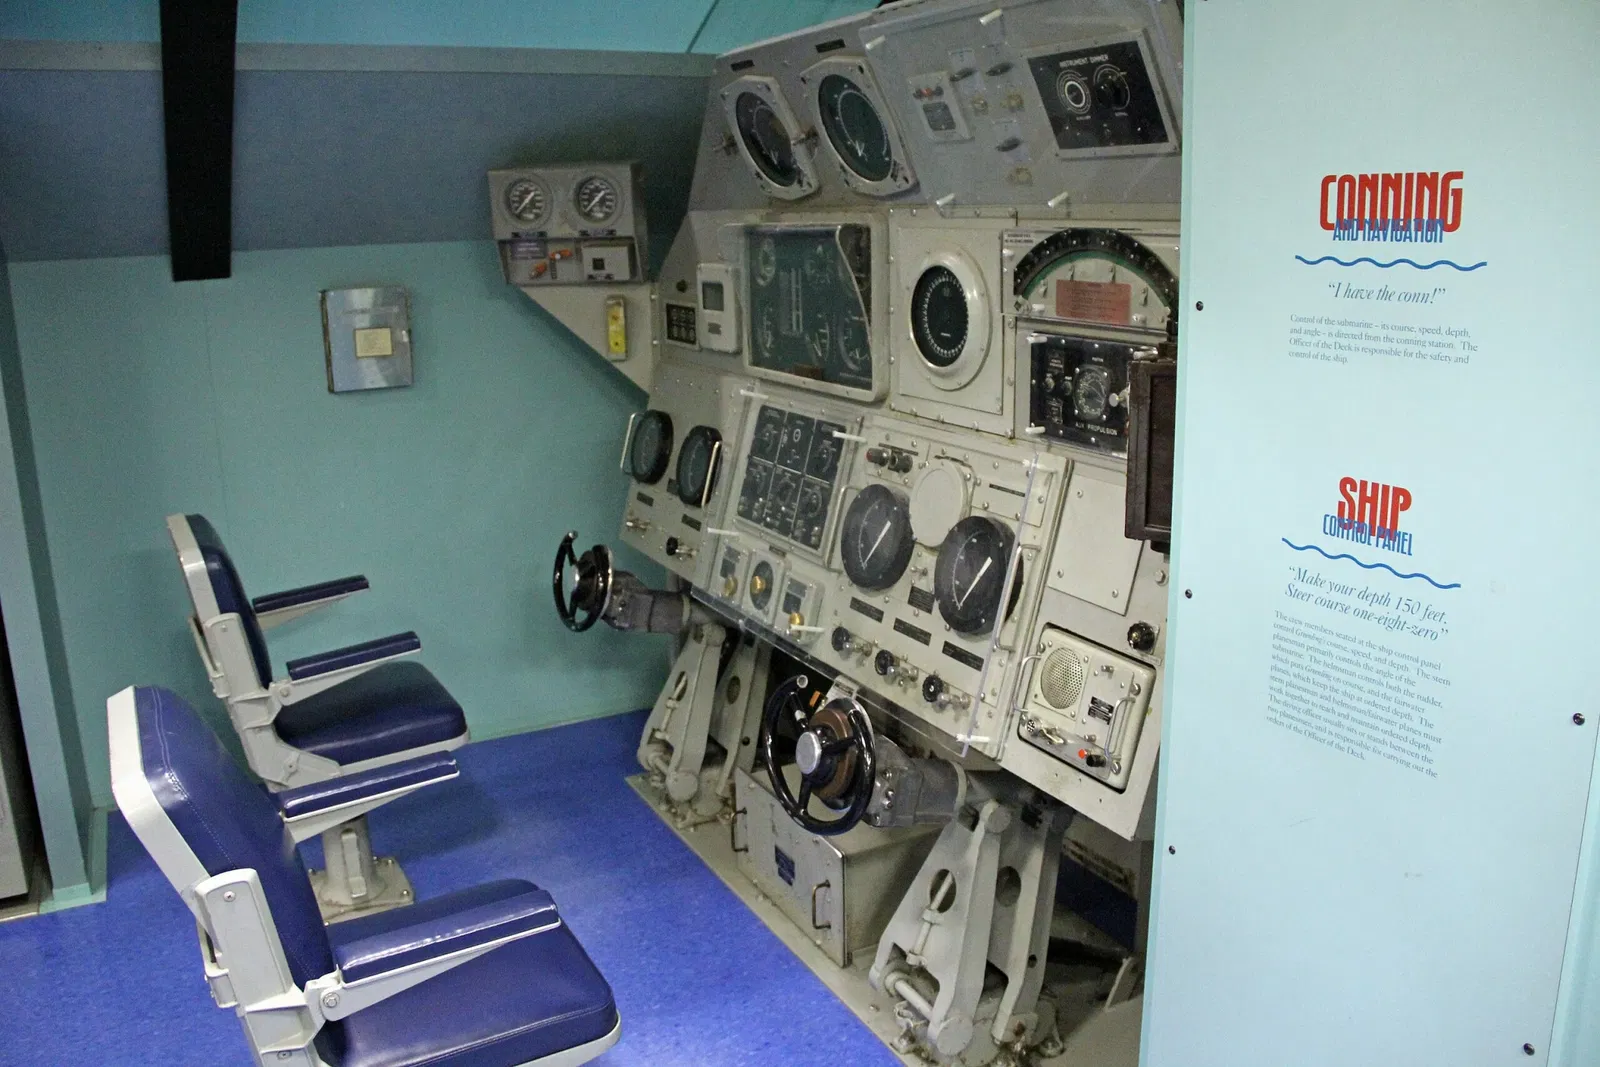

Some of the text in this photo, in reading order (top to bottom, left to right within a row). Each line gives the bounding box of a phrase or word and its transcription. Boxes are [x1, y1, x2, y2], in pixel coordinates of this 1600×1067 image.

[1059, 58, 1088, 67] INSTRUMENT
[1320, 171, 1464, 232] CONNING
[1333, 219, 1443, 243] AND NAVIGATION
[1291, 314, 1315, 323] Control
[1324, 317, 1336, 325] the
[1337, 319, 1373, 328] submarine
[1344, 284, 1374, 300] have
[1377, 285, 1395, 302] the
[1398, 287, 1446, 304] conn!”
[1290, 337, 1312, 347] Officer
[1322, 341, 1332, 349] the
[1334, 342, 1352, 351] Deck
[1362, 347, 1401, 356] responsible
[1404, 349, 1413, 358] for
[1416, 351, 1427, 359] the
[1430, 353, 1451, 364] safety
[1304, 328, 1321, 338] angle
[1335, 330, 1363, 340] directed
[1365, 333, 1381, 342] from
[1397, 339, 1426, 348] conning
[1461, 342, 1478, 351] The
[1321, 352, 1331, 361] the
[1333, 354, 1348, 364] ship.
[1088, 424, 1118, 435] PROPULSION
[1323, 514, 1413, 556] CONTROL PANEL
[1338, 476, 1412, 542] SHIP
[1286, 583, 1448, 641] Steer course one-eight-zero”
[1289, 567, 1447, 625] “Make your depth 150 feet.
[1273, 623, 1294, 634] control
[1375, 656, 1386, 665] and
[1415, 667, 1430, 680] The
[1432, 675, 1450, 687] stern
[1273, 632, 1416, 687] planesman primarily controls the angle of the
[1275, 610, 1287, 620] The
[1289, 617, 1302, 625] crew
[1305, 622, 1334, 636] members
[1336, 632, 1356, 643] seated
[1366, 640, 1376, 650] the
[1379, 644, 1393, 658] ship
[1394, 651, 1419, 664] control
[1421, 660, 1441, 671] panel
[1271, 664, 1291, 678] planes,
[1293, 672, 1311, 684] which
[1313, 677, 1328, 692] keep
[1330, 684, 1339, 694] the
[1342, 689, 1355, 702] ship
[1364, 698, 1390, 713] ordered
[1419, 716, 1434, 729] The
[1272, 644, 1442, 709] submarine. The helmsman controls both the rudder,
[1272, 653, 1290, 665] which
[1291, 661, 1303, 670] puts
[1367, 688, 1380, 698] and
[1382, 692, 1392, 702] the
[1394, 695, 1425, 714] fairwater
[1266, 715, 1366, 761] orders of the Officer of the Deck.
[1268, 693, 1281, 705] The
[1283, 698, 1301, 715] diving
[1302, 707, 1322, 721] officer
[1324, 717, 1344, 732] usually
[1347, 725, 1357, 735] sits
[1367, 734, 1388, 747] stands
[1390, 740, 1419, 759] between
[1422, 754, 1433, 765] the
[1270, 675, 1284, 685] stern
[1286, 679, 1318, 697] planesman
[1320, 693, 1331, 702] and
[1400, 722, 1421, 736] planes
[1424, 732, 1442, 744] must
[1270, 685, 1283, 695] work
[1285, 690, 1310, 705] together
[1312, 700, 1318, 708] to
[1319, 704, 1335, 715] reach
[1337, 711, 1349, 720] and
[1351, 716, 1379, 732] maintain
[1381, 728, 1407, 743] ordered
[1268, 705, 1438, 778] two planesmen, and is responsible for carrying out the
